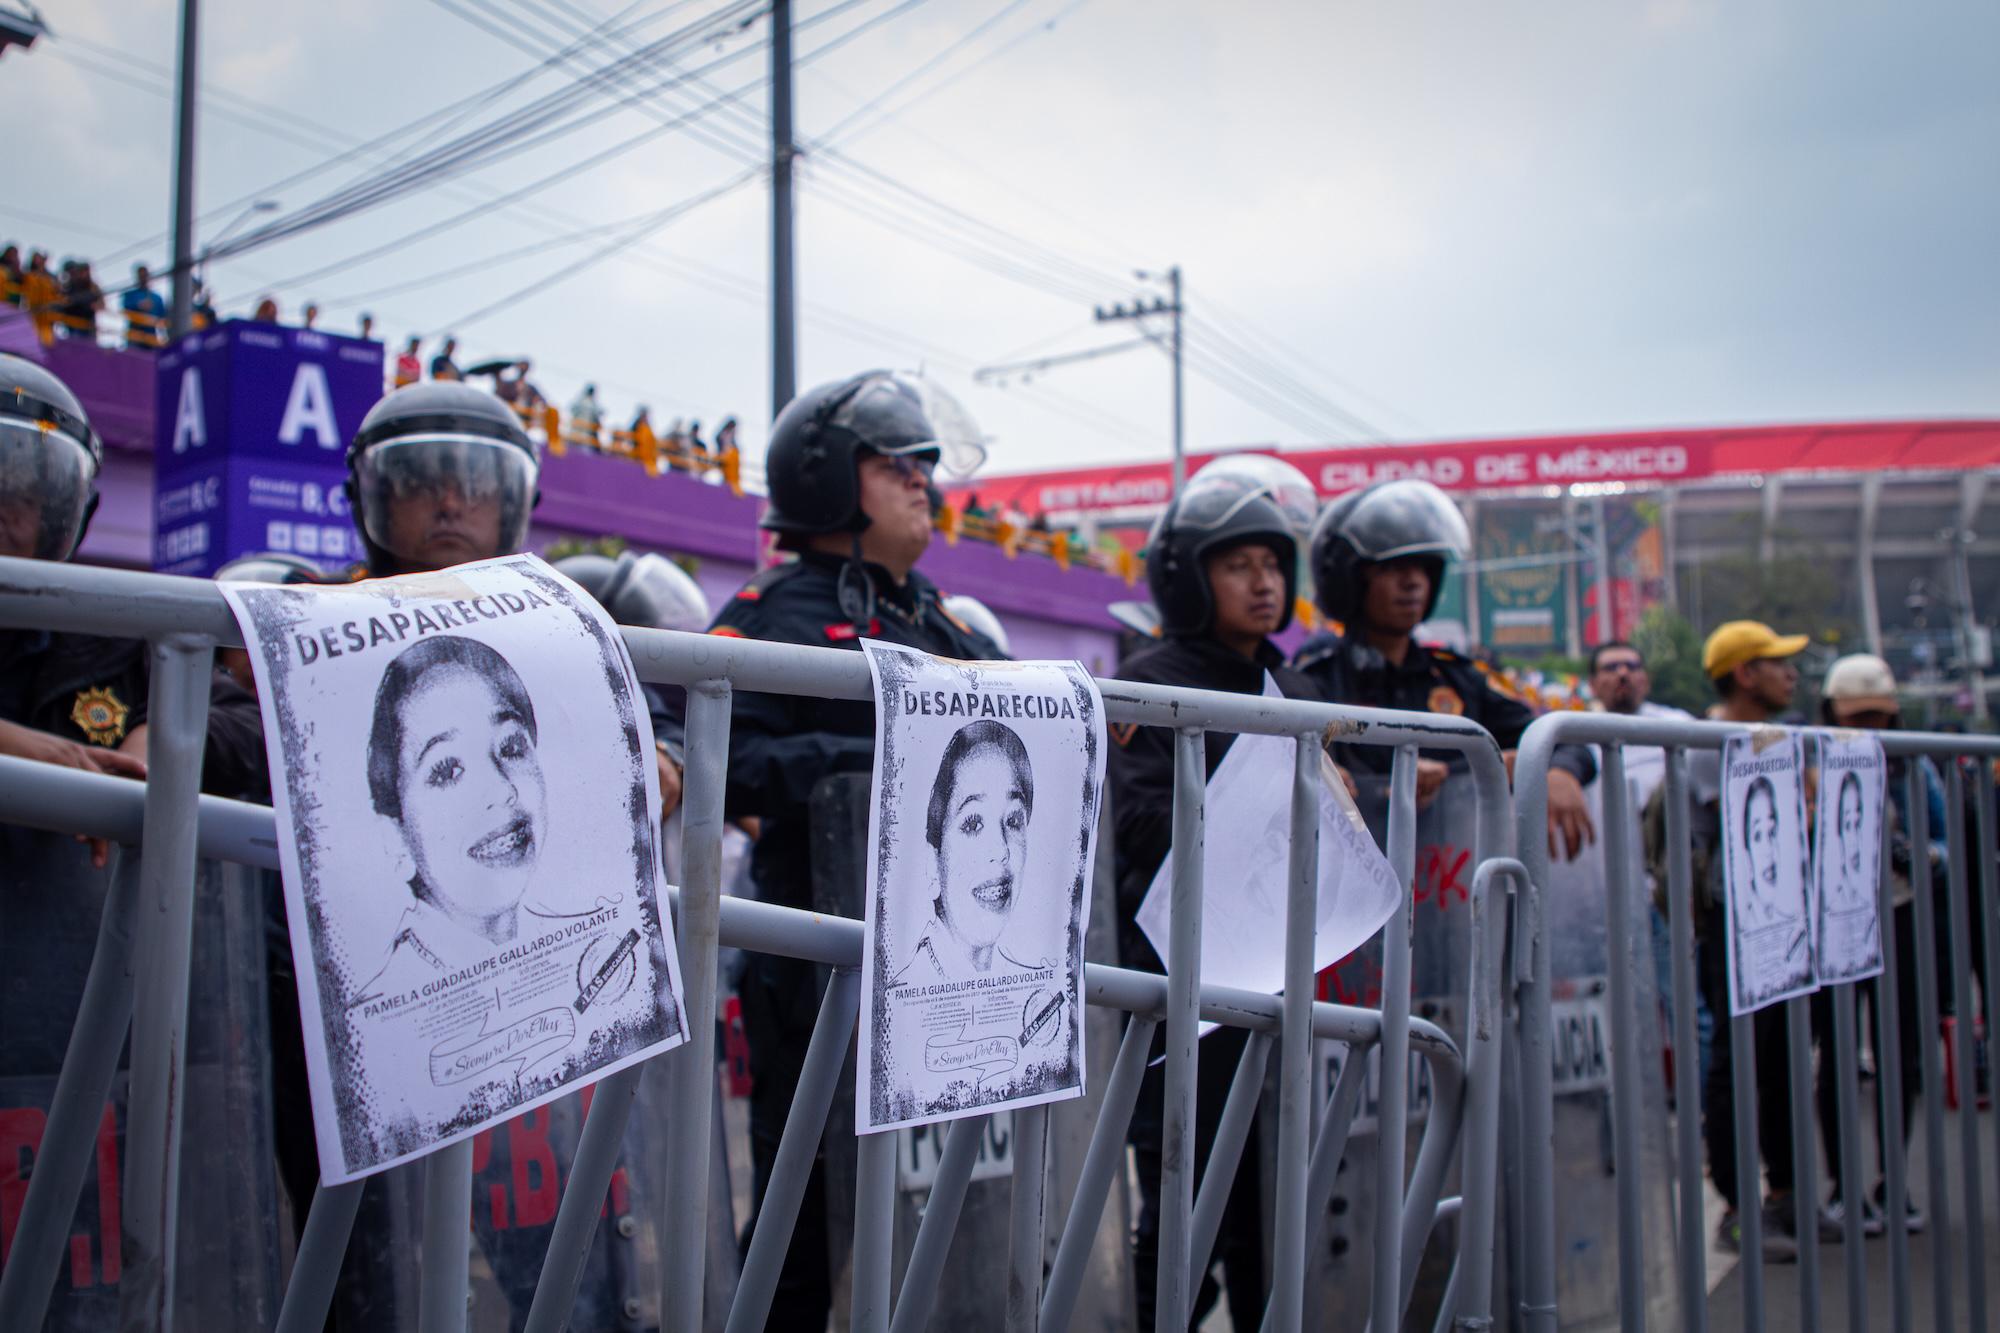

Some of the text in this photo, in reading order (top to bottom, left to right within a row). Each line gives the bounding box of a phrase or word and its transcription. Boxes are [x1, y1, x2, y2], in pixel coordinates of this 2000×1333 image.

[173, 365, 208, 455] A
[278, 362, 341, 450] A
[1320, 444, 1688, 491] CIUDAD DE MÉXICO
[1040, 478, 1168, 509] ESTADIO
[294, 589, 552, 666] DESAPARECIDA
[904, 690, 1075, 719] DESAPARECIDA
[1732, 757, 1793, 778] DESAPARECIDA
[1828, 756, 1877, 769] DESAPARECIDA
[364, 990, 419, 1019] PAMELA
[422, 957, 497, 996] GUADALUPE
[499, 930, 564, 965] GALLARDO
[564, 908, 619, 937] VOLANTE
[895, 970, 1054, 1000] PAMELA GUADALUPE GALLARDO VOLANTE
